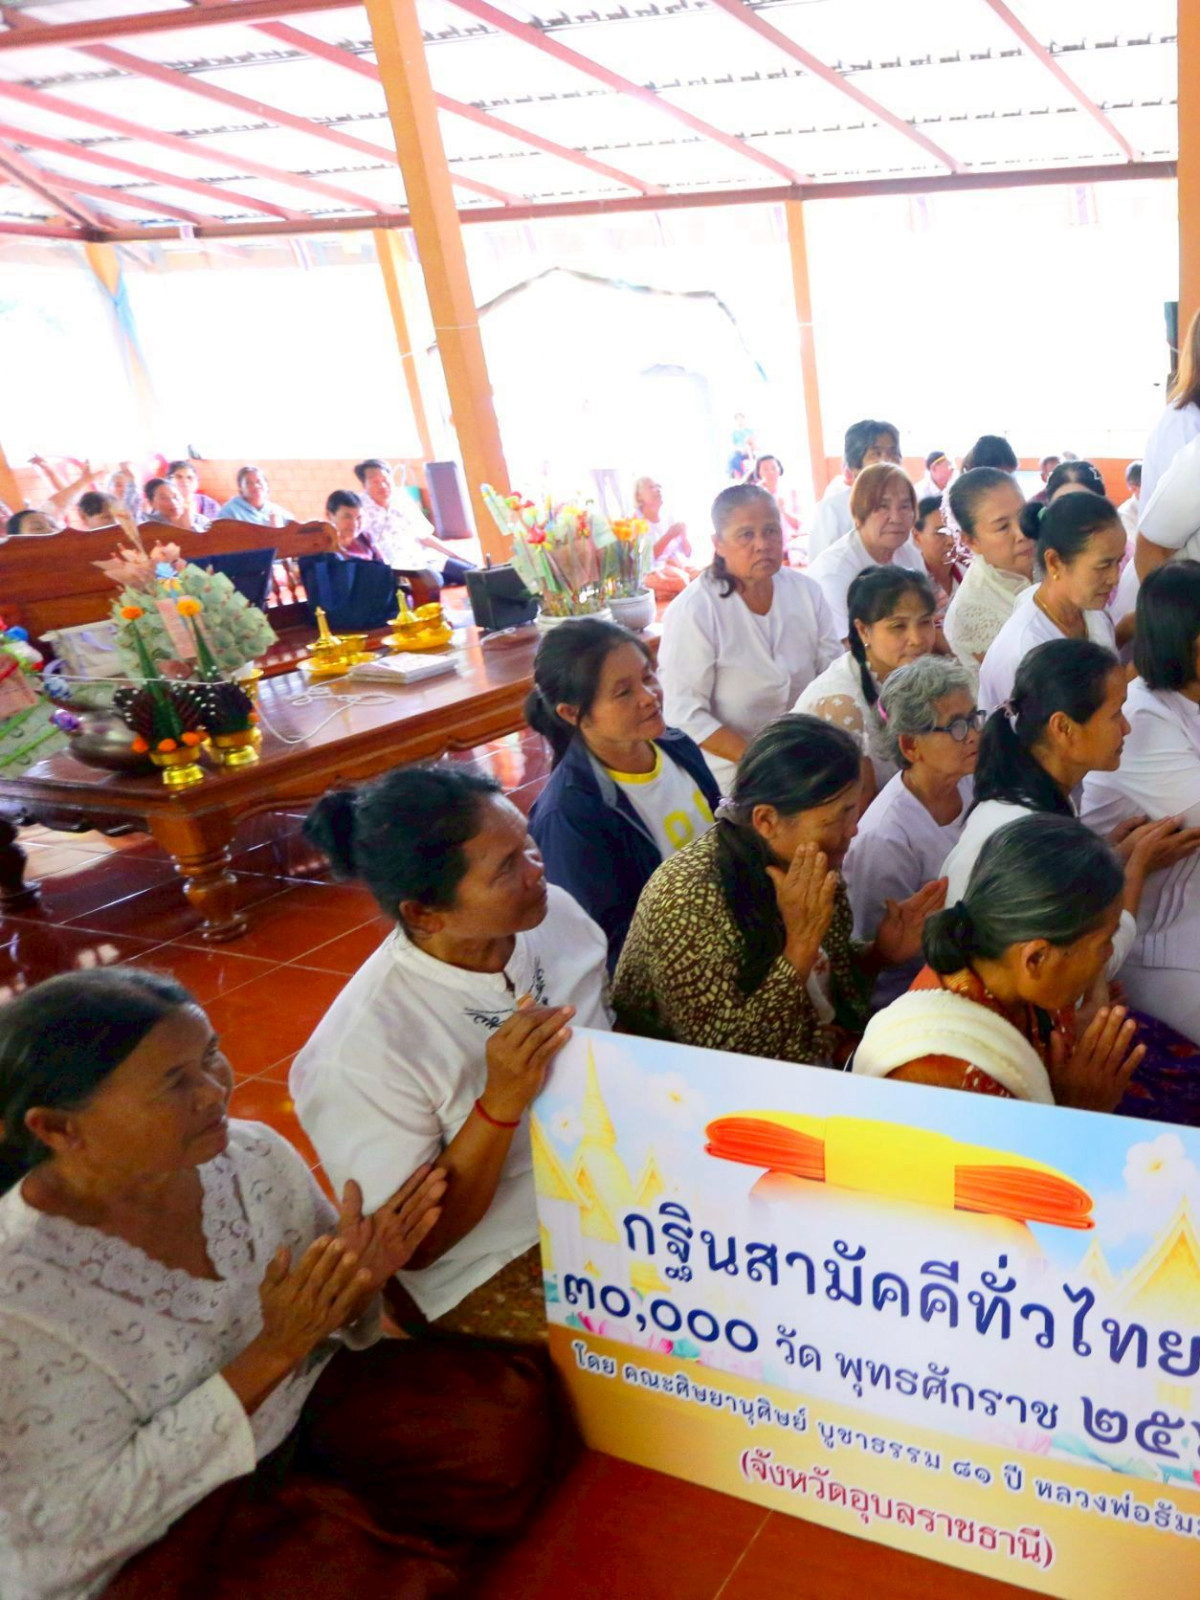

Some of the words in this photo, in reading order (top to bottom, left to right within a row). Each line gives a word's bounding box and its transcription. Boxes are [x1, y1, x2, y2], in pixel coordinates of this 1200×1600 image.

[564, 1274, 759, 1353] ๓๐,๐๐๐
[776, 1325, 822, 1372] วัด
[835, 1352, 1059, 1429] พุทธศักราช
[573, 1341, 616, 1375] โดย
[625, 1366, 807, 1431] คณะศิษยานุศิษย์
[818, 1421, 941, 1469] บูชาธรรม
[953, 1461, 992, 1484] ๘๑
[1004, 1465, 1022, 1490] ปี
[742, 1449, 1054, 1568] (จังหวัดอุบลราชธานี)
